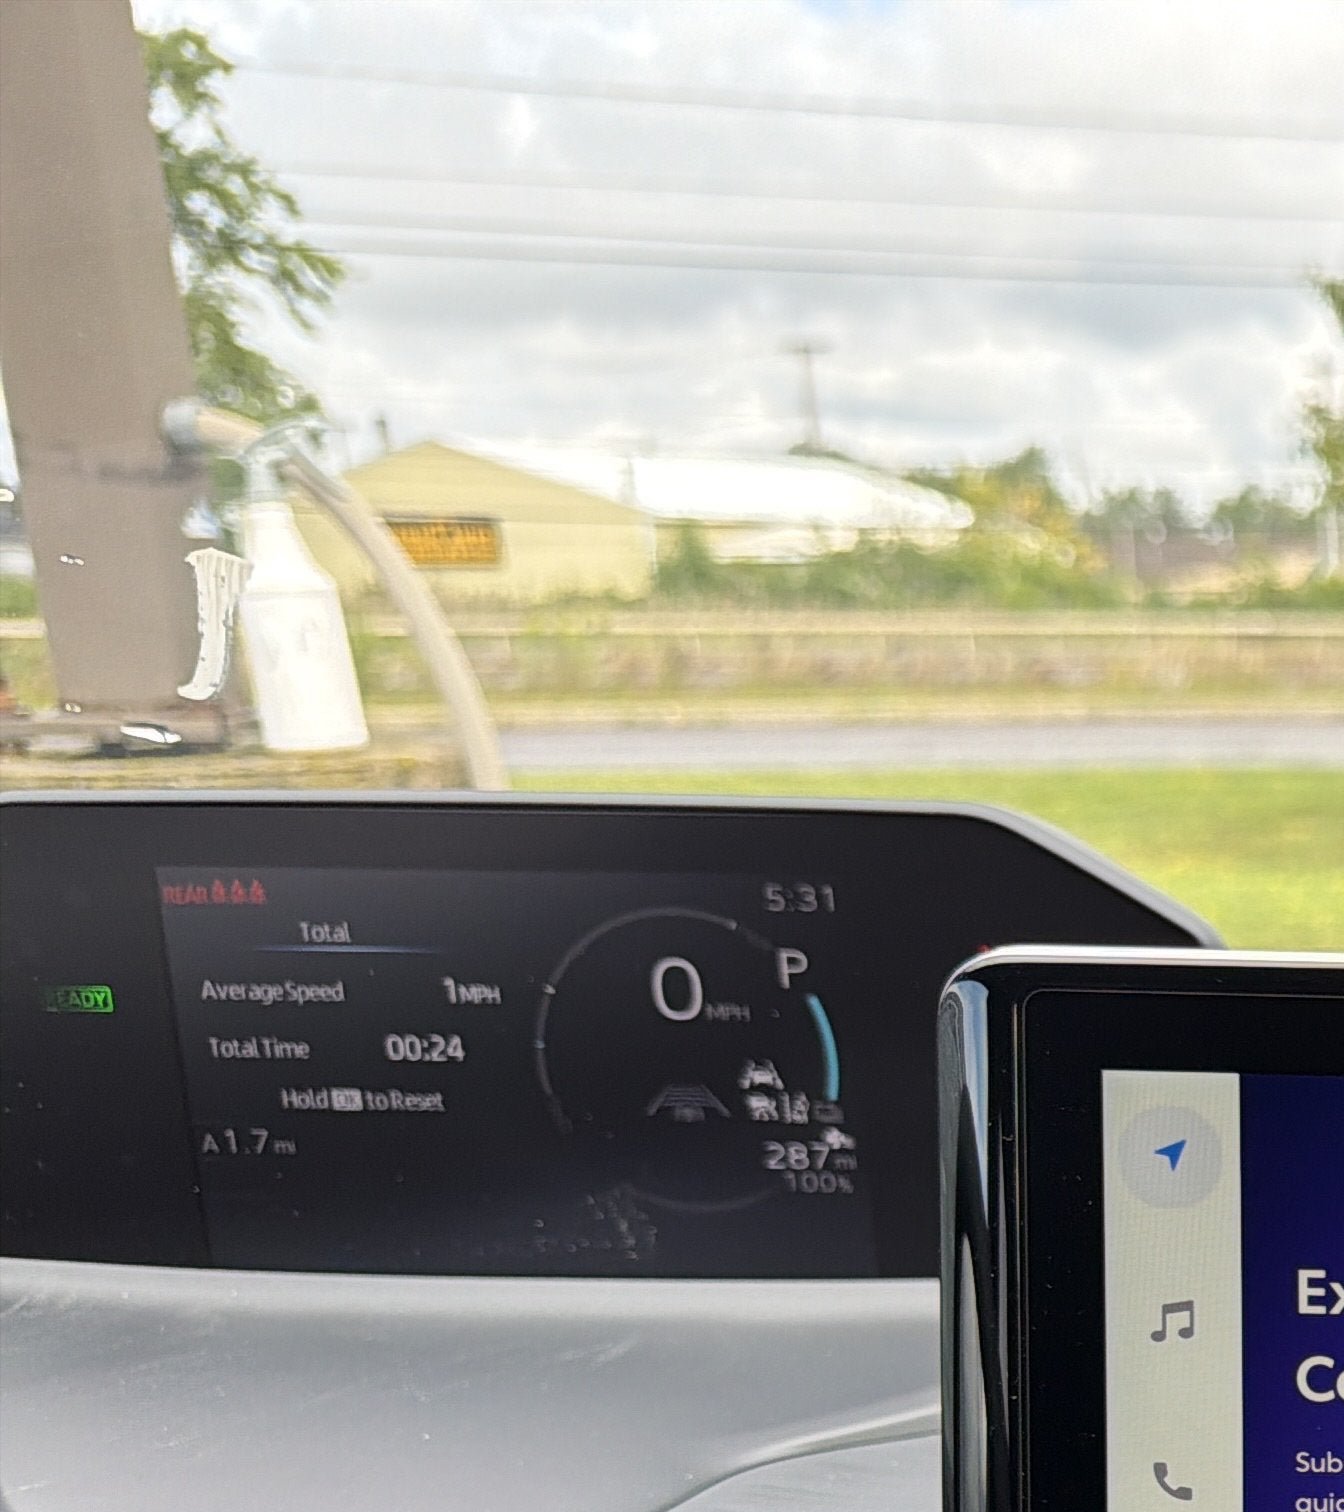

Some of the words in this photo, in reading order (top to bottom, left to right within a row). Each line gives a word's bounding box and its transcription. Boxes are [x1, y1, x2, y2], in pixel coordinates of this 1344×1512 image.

[762, 882, 836, 913] 5:31
[300, 921, 351, 944] Total
[775, 947, 809, 990] P
[202, 979, 284, 1006] Average
[284, 979, 345, 1006] Speed
[441, 977, 457, 1004] 1
[459, 984, 501, 1005] MPH
[651, 956, 704, 1021] 0
[703, 1003, 750, 1022] MPH
[208, 1036, 258, 1060] Total
[261, 1036, 310, 1060] Time
[384, 1033, 466, 1062] 00:24
[281, 1088, 328, 1110] Hold
[367, 1090, 389, 1112] to
[390, 1090, 446, 1113] Reset
[202, 1132, 221, 1154] A
[224, 1128, 270, 1155] 1.7
[762, 1140, 830, 1170] 287
